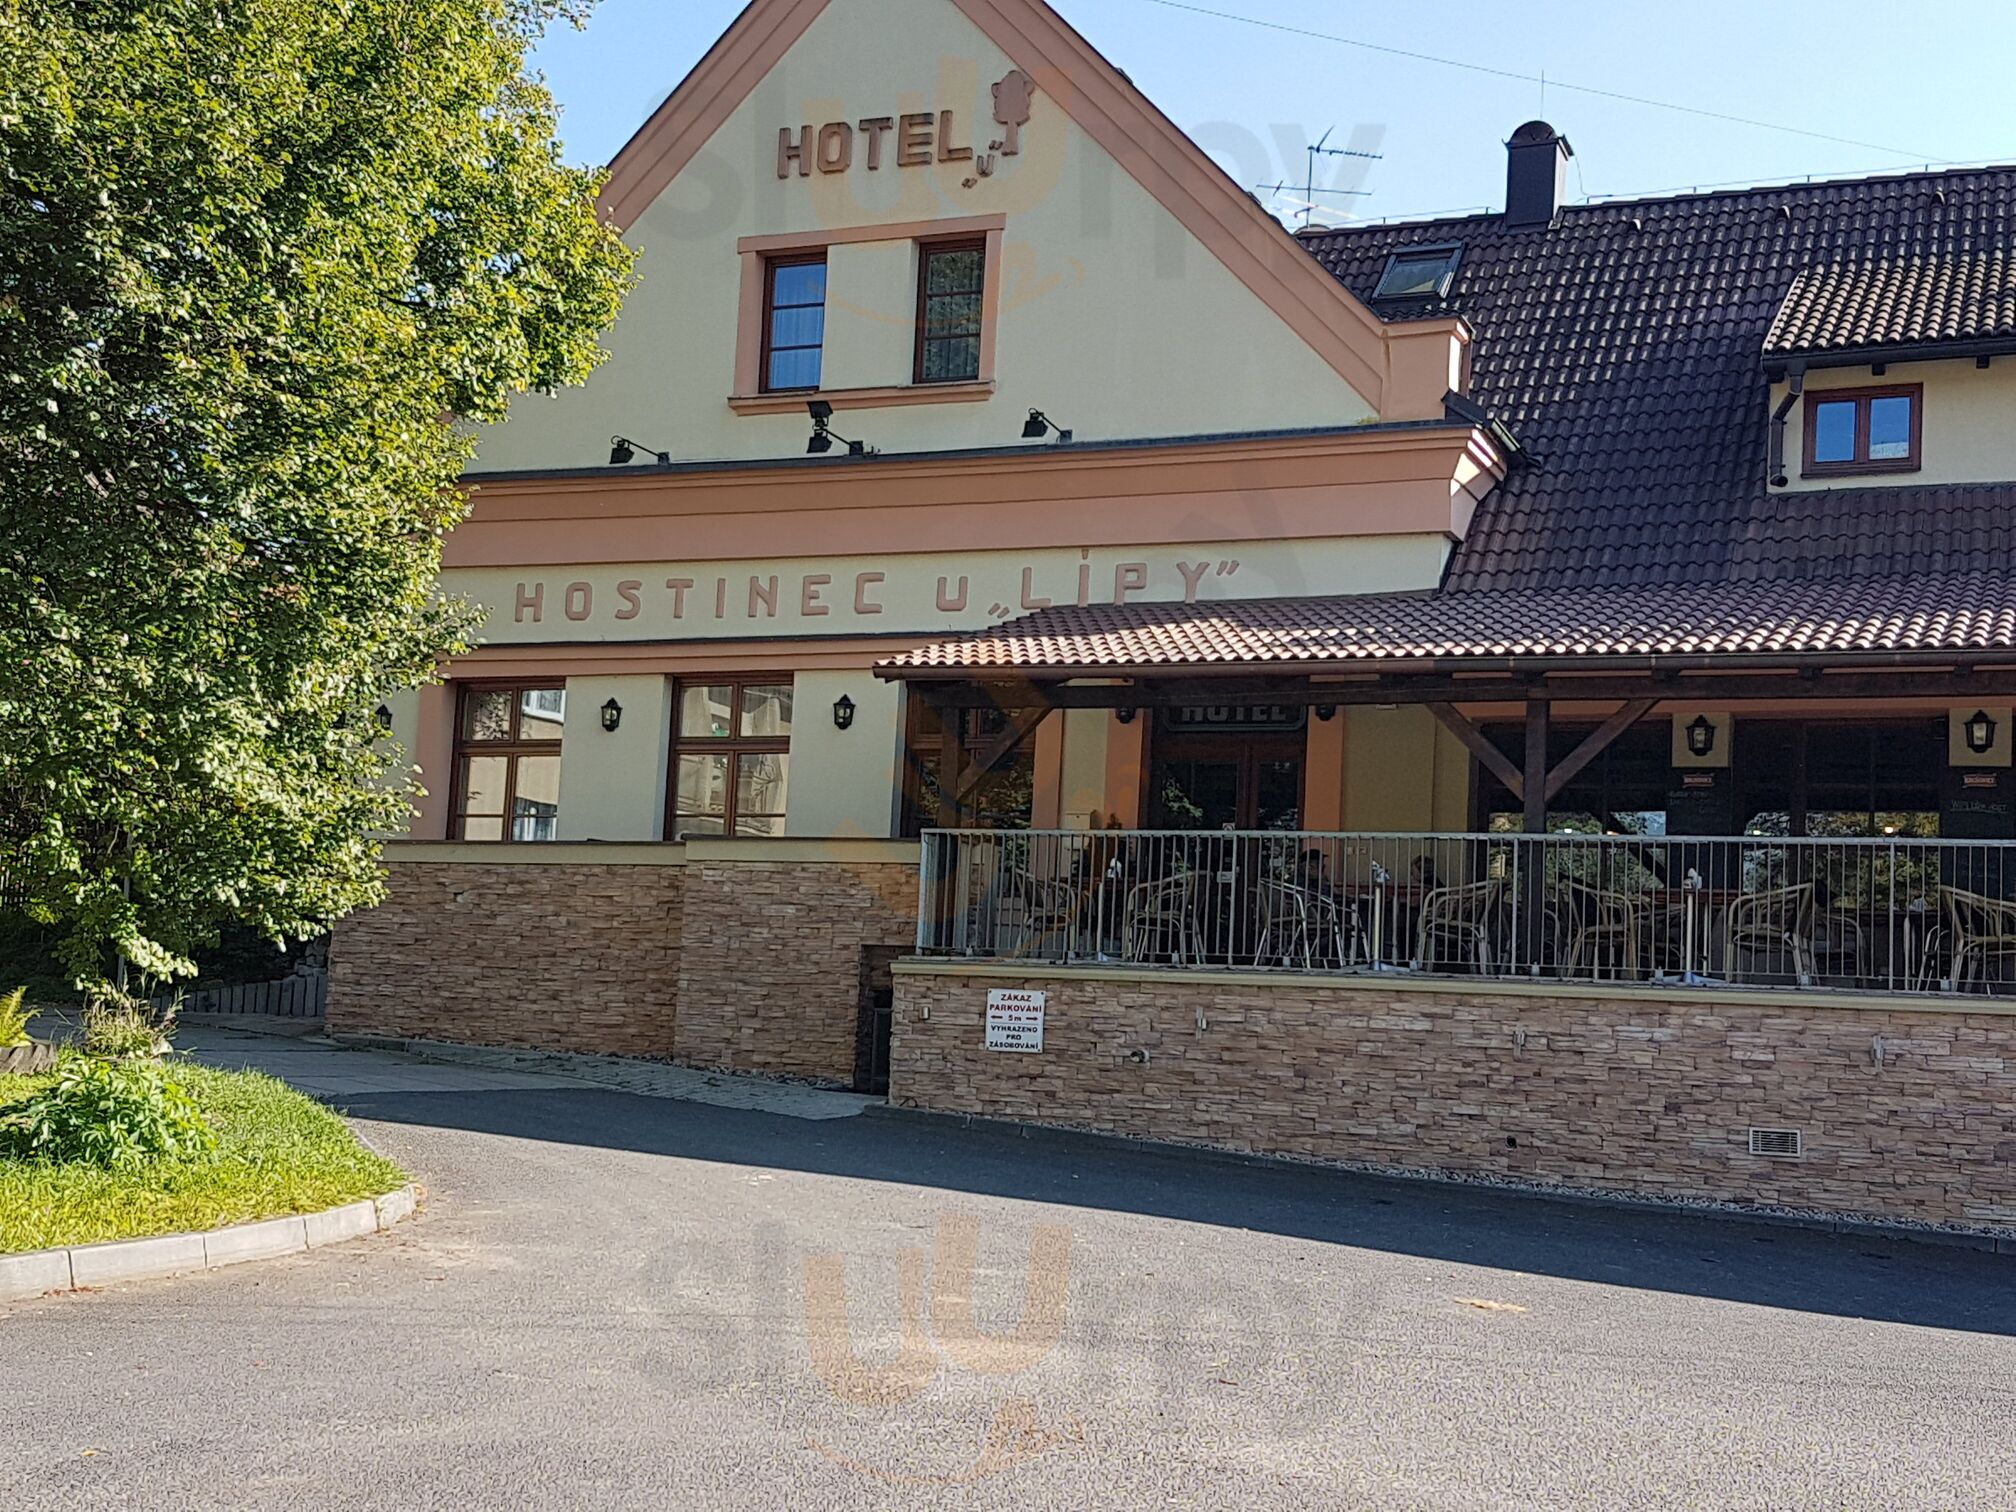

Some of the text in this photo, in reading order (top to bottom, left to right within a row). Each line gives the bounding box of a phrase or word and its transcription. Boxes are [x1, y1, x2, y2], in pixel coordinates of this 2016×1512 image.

[777, 110, 973, 179] HOTEL
[514, 572, 885, 623] HOSTINEC
[936, 576, 969, 613] U
[1001, 993, 1032, 1002] ZÁKAZ
[991, 1025, 1038, 1033] VYHRAZENO
